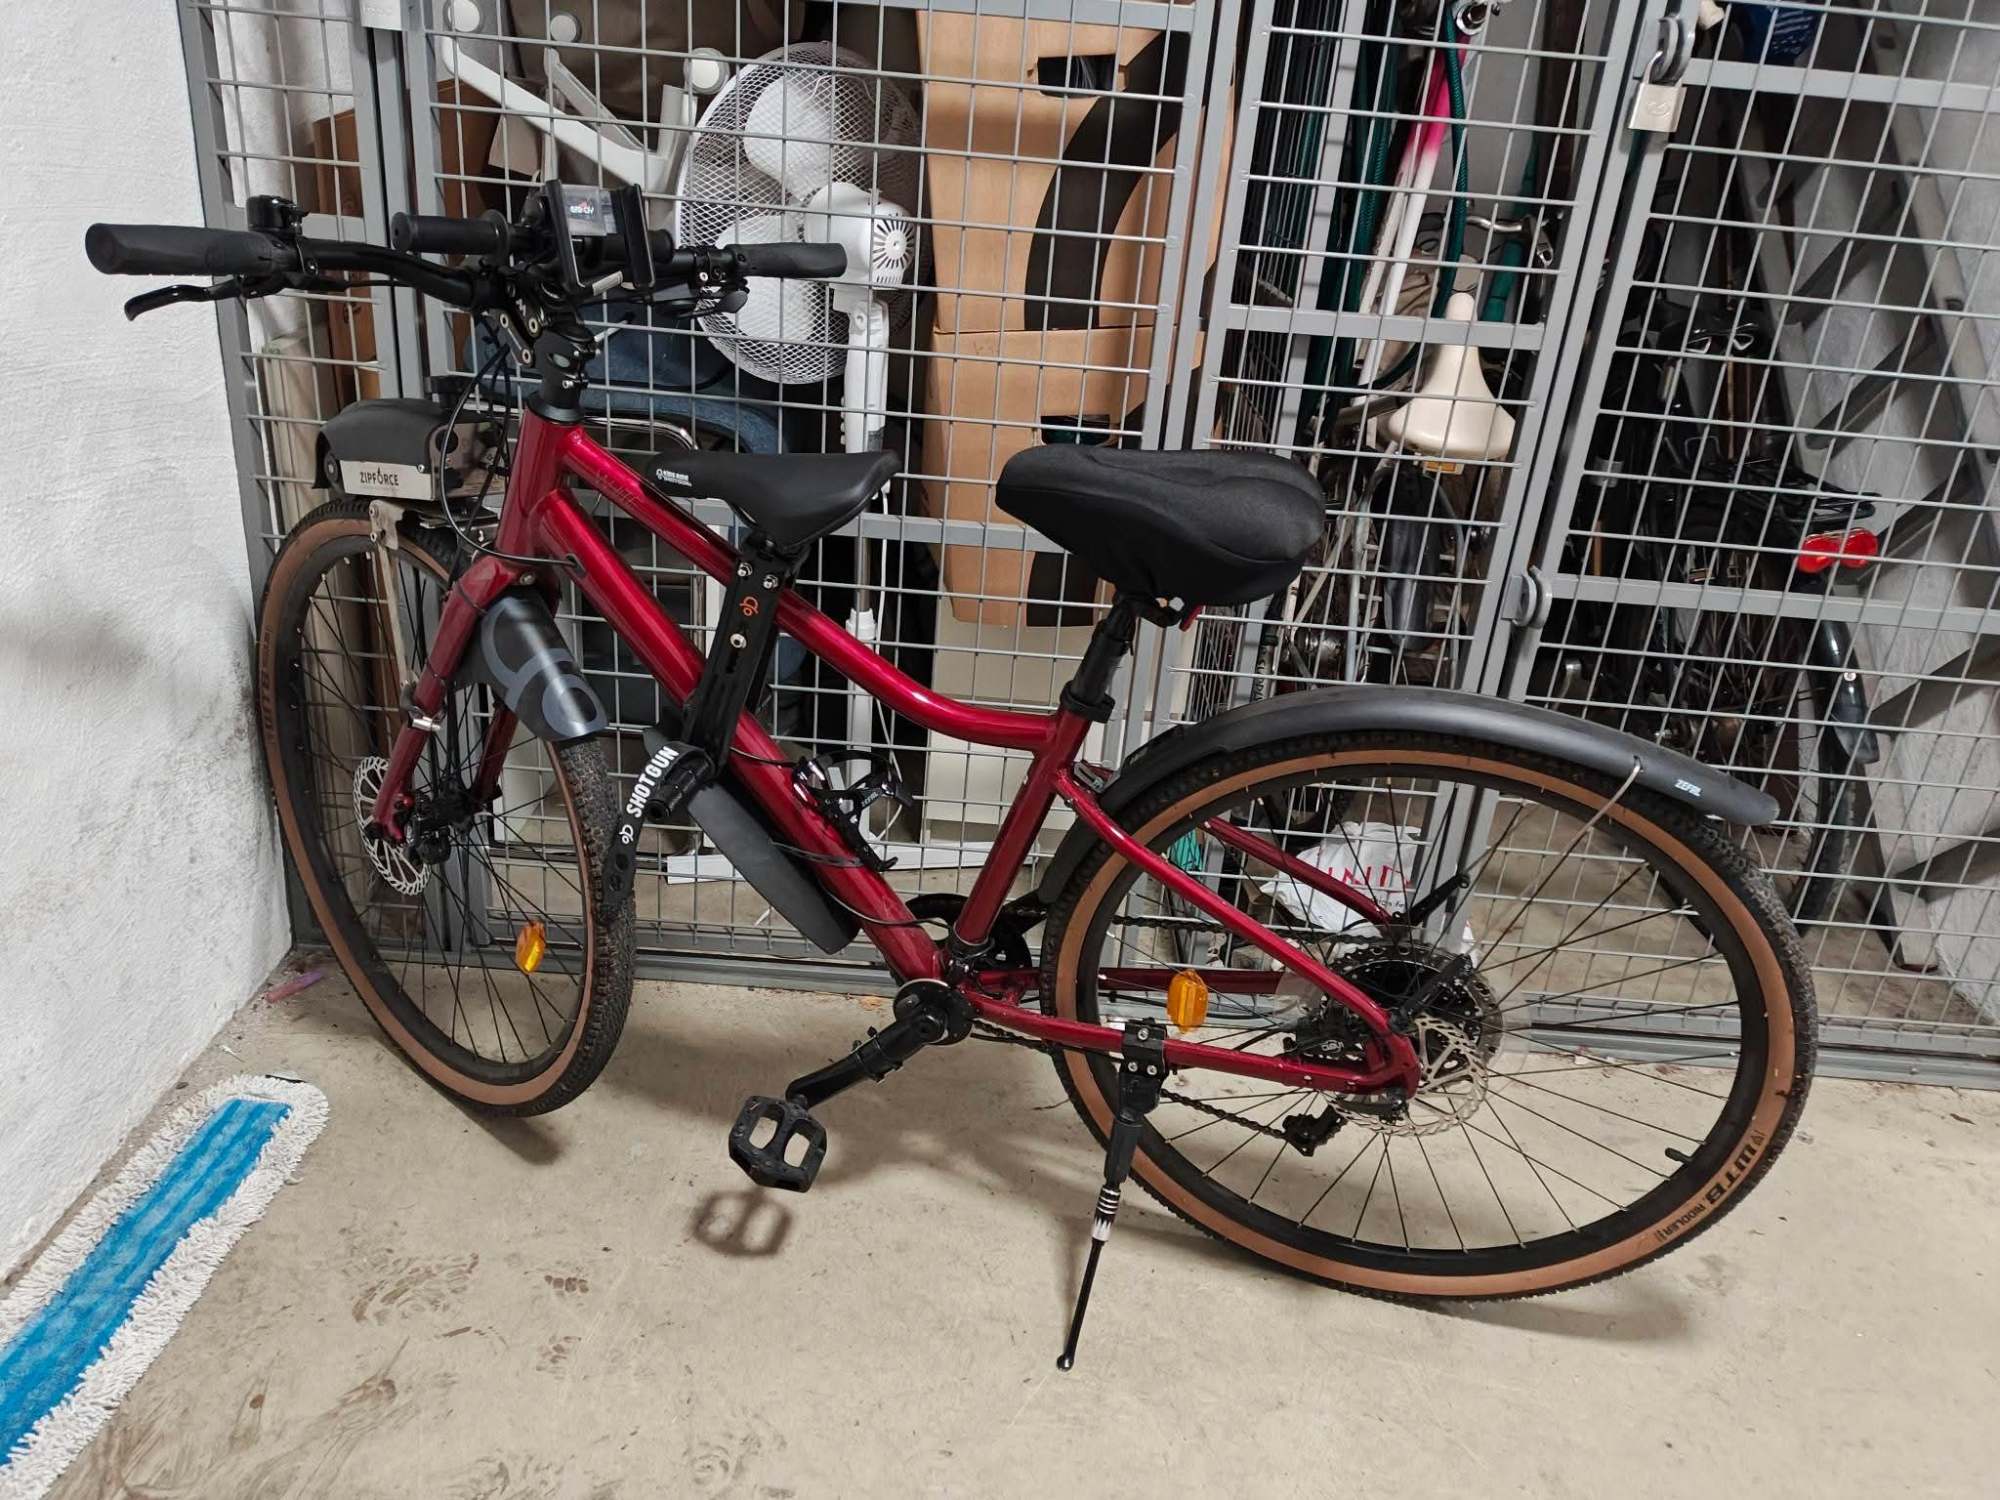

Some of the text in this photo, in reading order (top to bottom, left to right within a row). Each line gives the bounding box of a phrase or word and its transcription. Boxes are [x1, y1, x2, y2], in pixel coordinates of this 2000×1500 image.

[360, 467, 399, 486] ZIPFORCE
[626, 745, 680, 818] SHOTGUN
[1662, 1143, 1758, 1237] WTB RIDDLER
